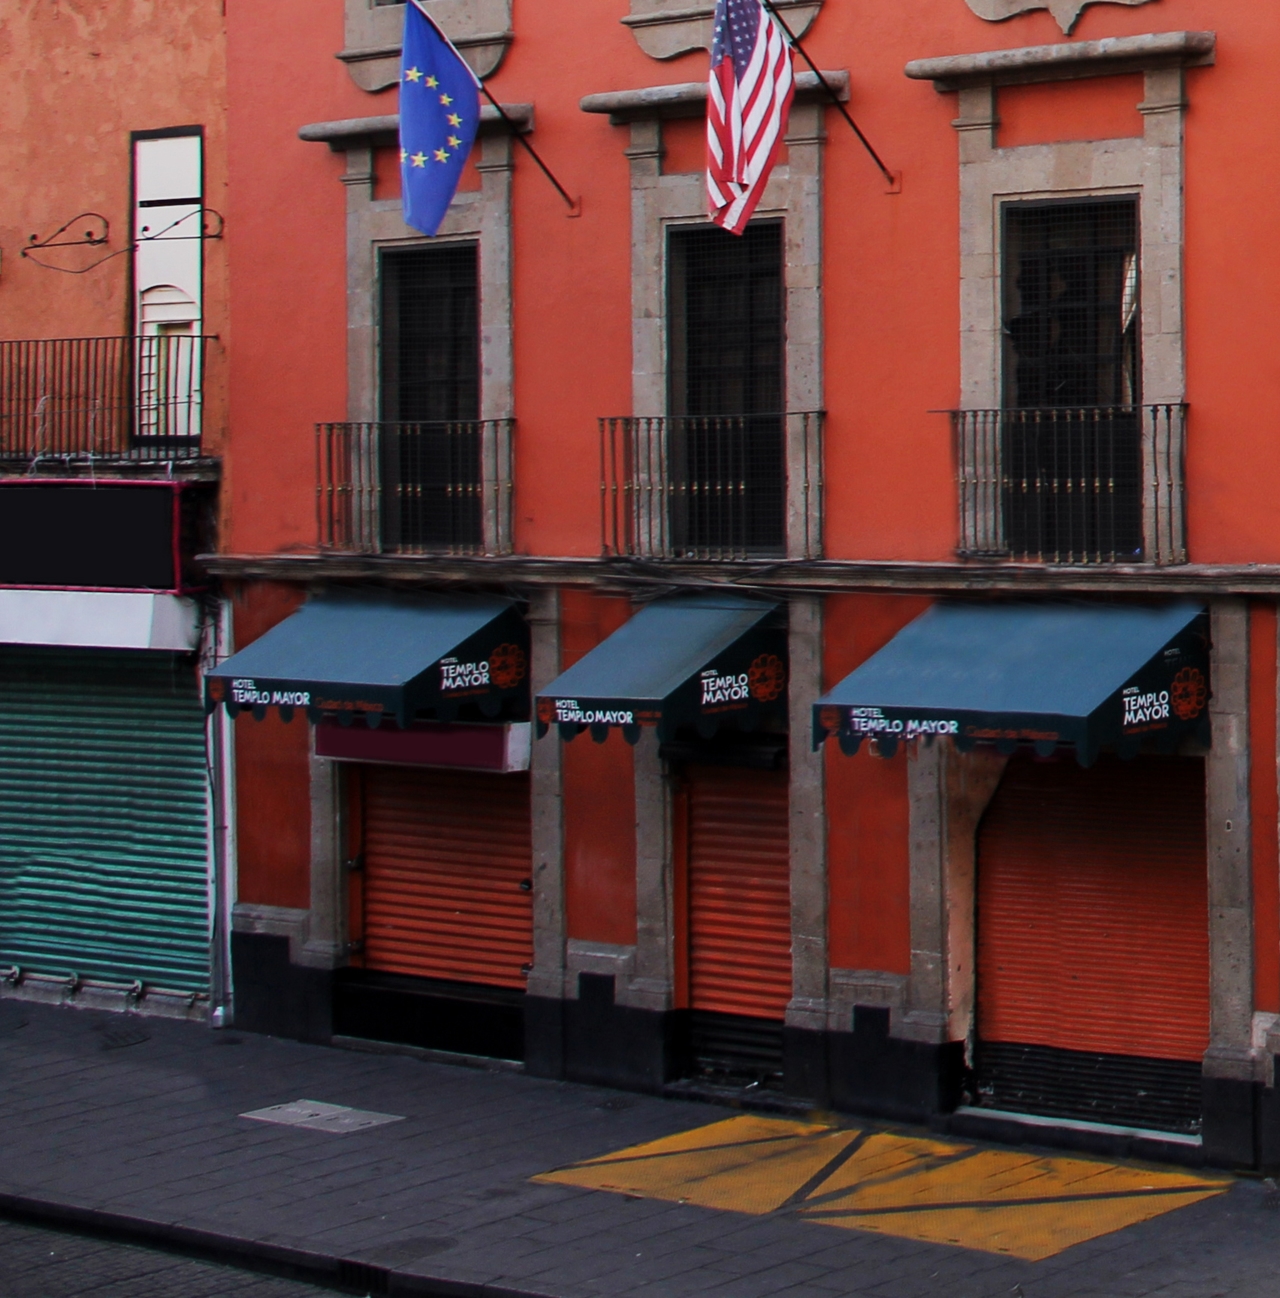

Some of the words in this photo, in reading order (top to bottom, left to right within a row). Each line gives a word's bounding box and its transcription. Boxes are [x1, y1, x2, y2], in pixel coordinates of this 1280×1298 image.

[441, 661, 489, 677] TEMPLO
[232, 679, 256, 689] HOTEL
[441, 673, 490, 690] MAYOR
[702, 674, 748, 691] TEMPLO
[232, 690, 270, 703] TEMPLO
[272, 692, 310, 705] MAYOR
[702, 686, 749, 704] MAYOR
[1123, 686, 1140, 695] HOTEL
[556, 700, 579, 709] HOTEL
[1123, 691, 1169, 710] TEMPLO
[557, 710, 594, 722] TEMPLO
[595, 711, 633, 723] MAYOR
[851, 707, 884, 718] HOTEL
[1123, 704, 1169, 725] MAYOR
[852, 718, 903, 732] TEMPLO
[907, 720, 958, 734] MAYOR
